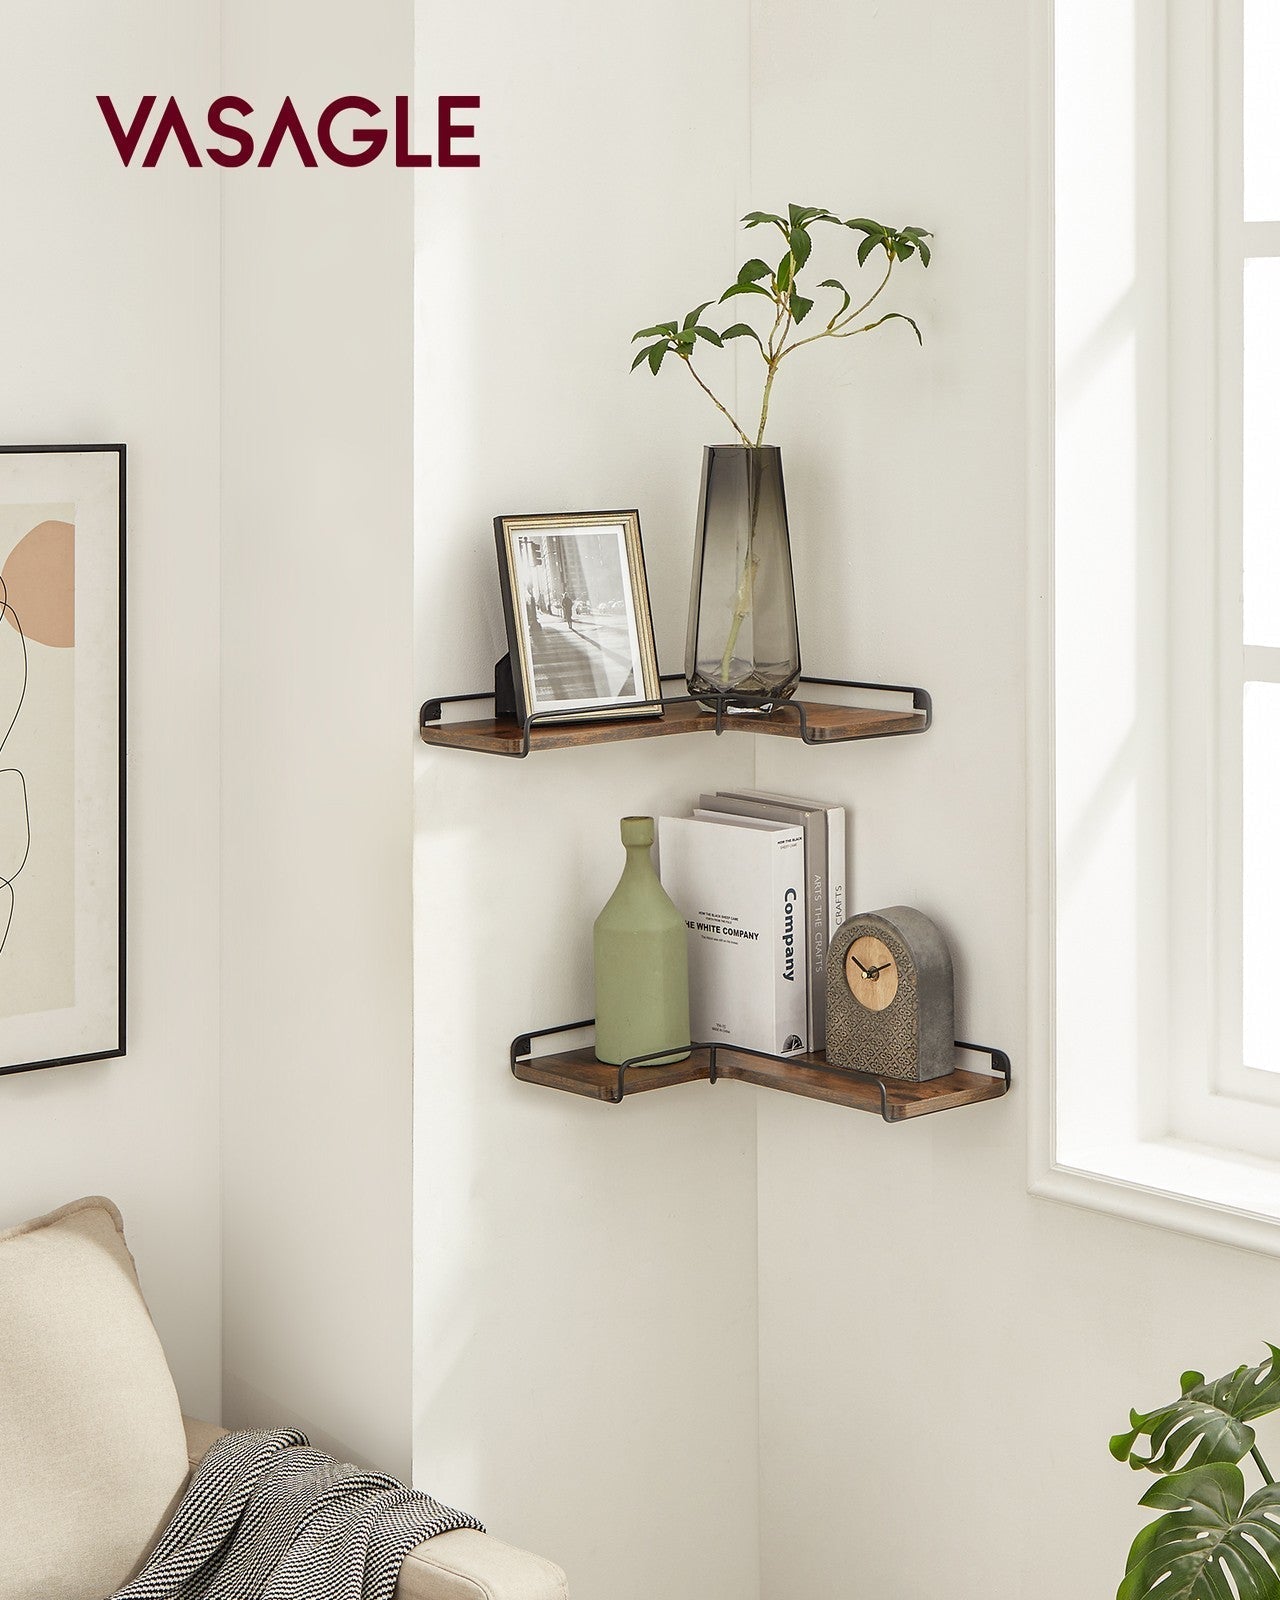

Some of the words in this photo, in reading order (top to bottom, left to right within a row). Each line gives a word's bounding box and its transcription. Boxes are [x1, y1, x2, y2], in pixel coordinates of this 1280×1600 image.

[814, 874, 822, 901] ARTS
[685, 920, 695, 929] HE
[696, 922, 721, 934] WHITE
[722, 926, 759, 940] COMPANY
[814, 907, 822, 928] THE
[782, 887, 797, 981] Company
[815, 932, 823, 973] CRAFTS
